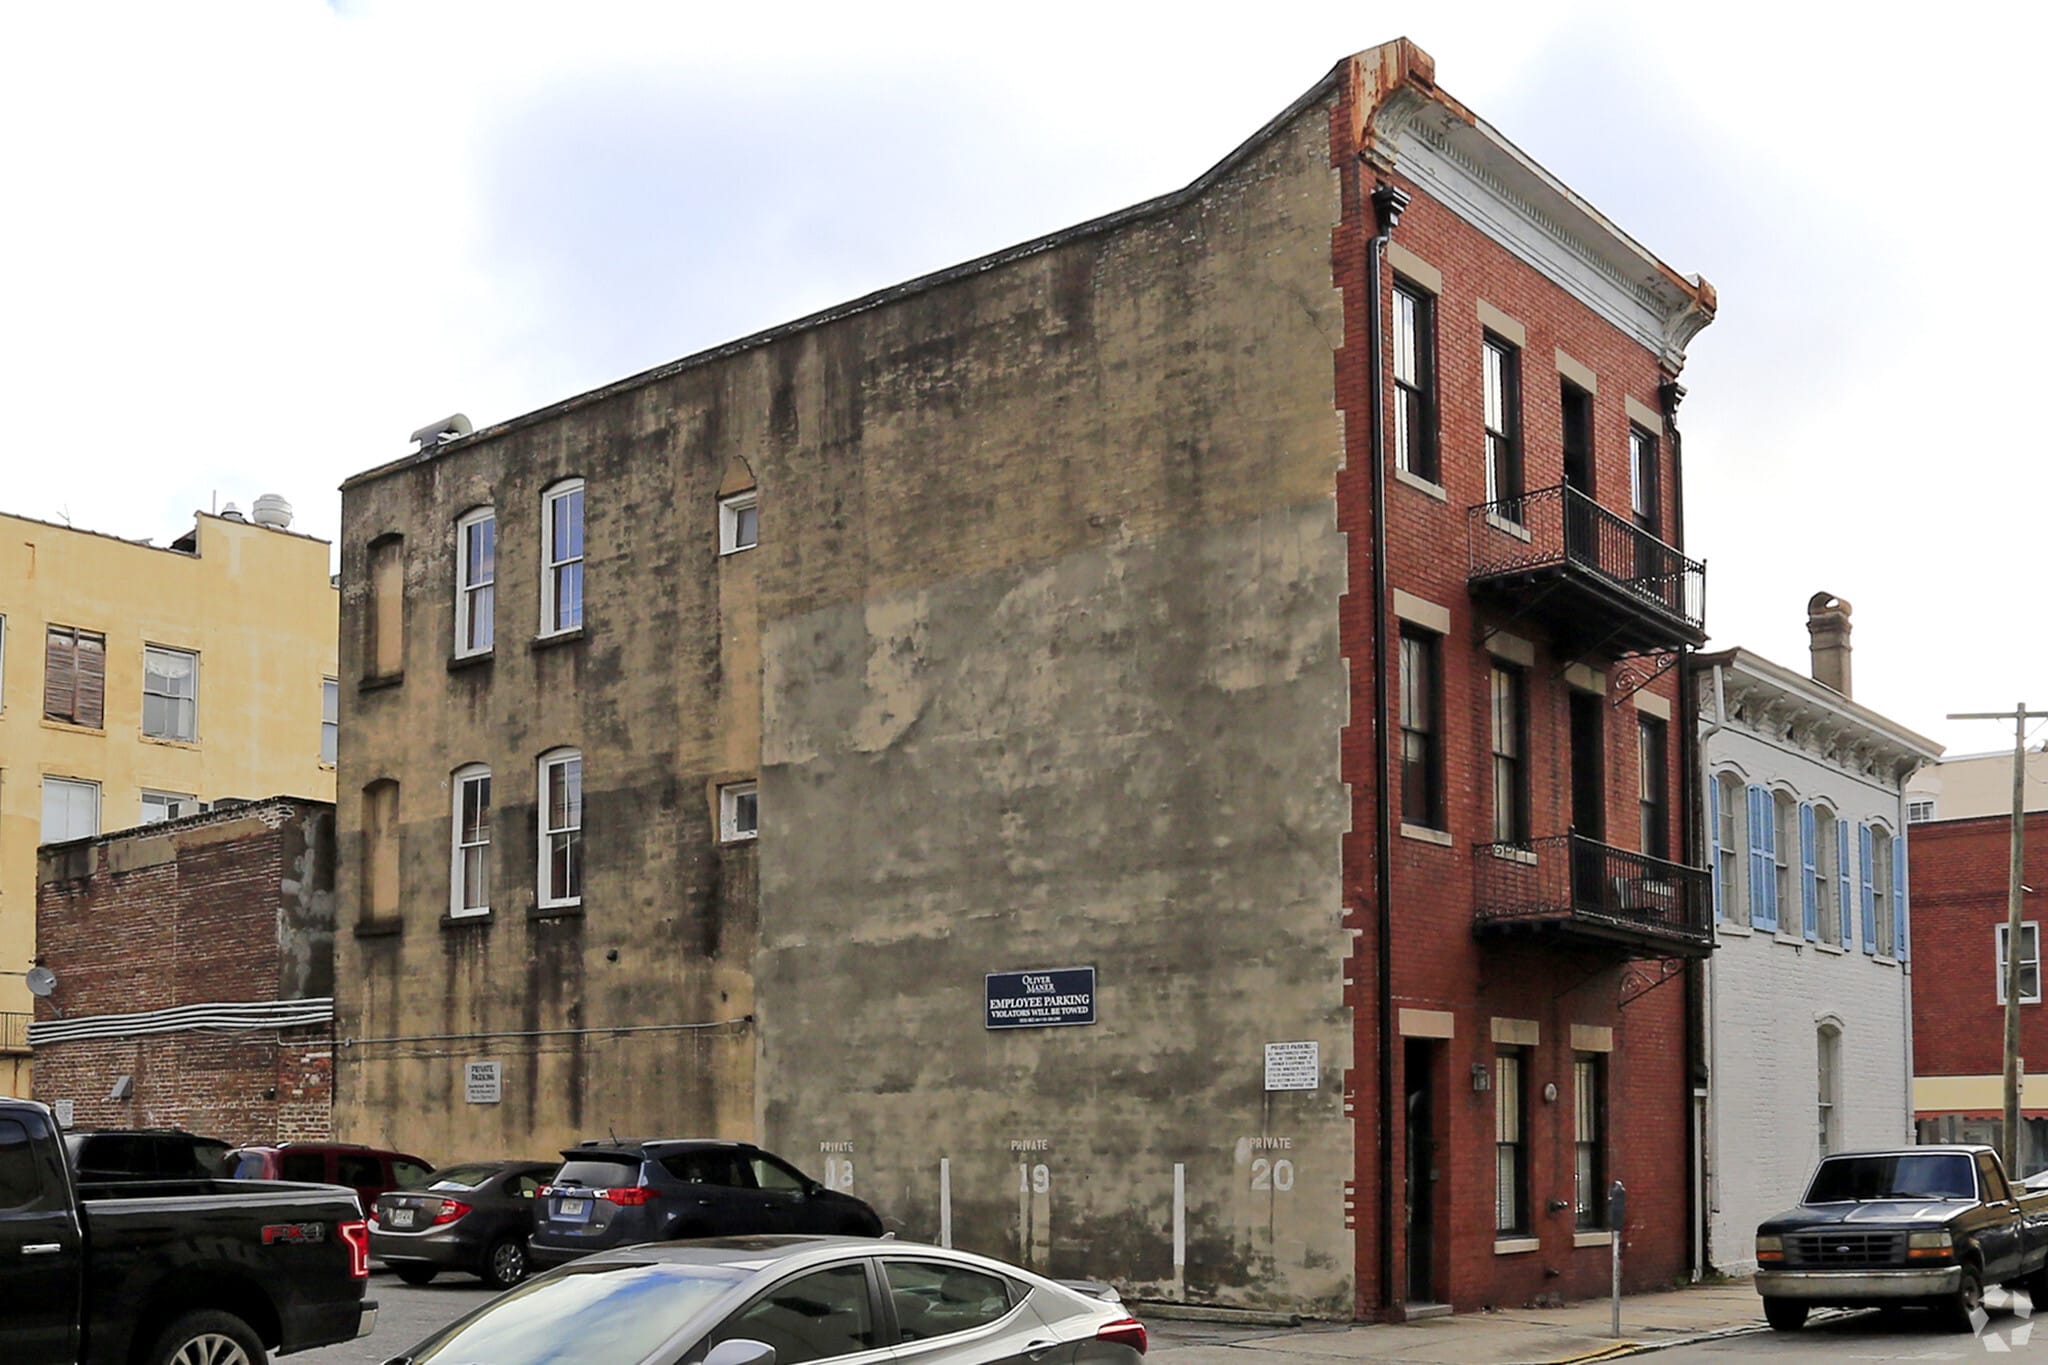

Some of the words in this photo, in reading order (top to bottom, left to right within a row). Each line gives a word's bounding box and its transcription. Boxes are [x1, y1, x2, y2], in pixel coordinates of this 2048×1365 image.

[990, 997, 1043, 1009] EMPLOYEE
[1044, 994, 1089, 1006] PARKING
[991, 1009, 1030, 1018] VIOLATORS
[1031, 1007, 1050, 1016] WILL
[1051, 1006, 1060, 1015] BE
[1061, 1006, 1088, 1015] TOWED
[820, 1141, 853, 1152] PRIVATE
[1011, 1139, 1048, 1151] PRIVATE
[1250, 1137, 1292, 1149] PRIVATE
[1019, 1163, 1050, 1193] 19
[1251, 1158, 1294, 1191] 20
[262, 1223, 323, 1244] FX4
